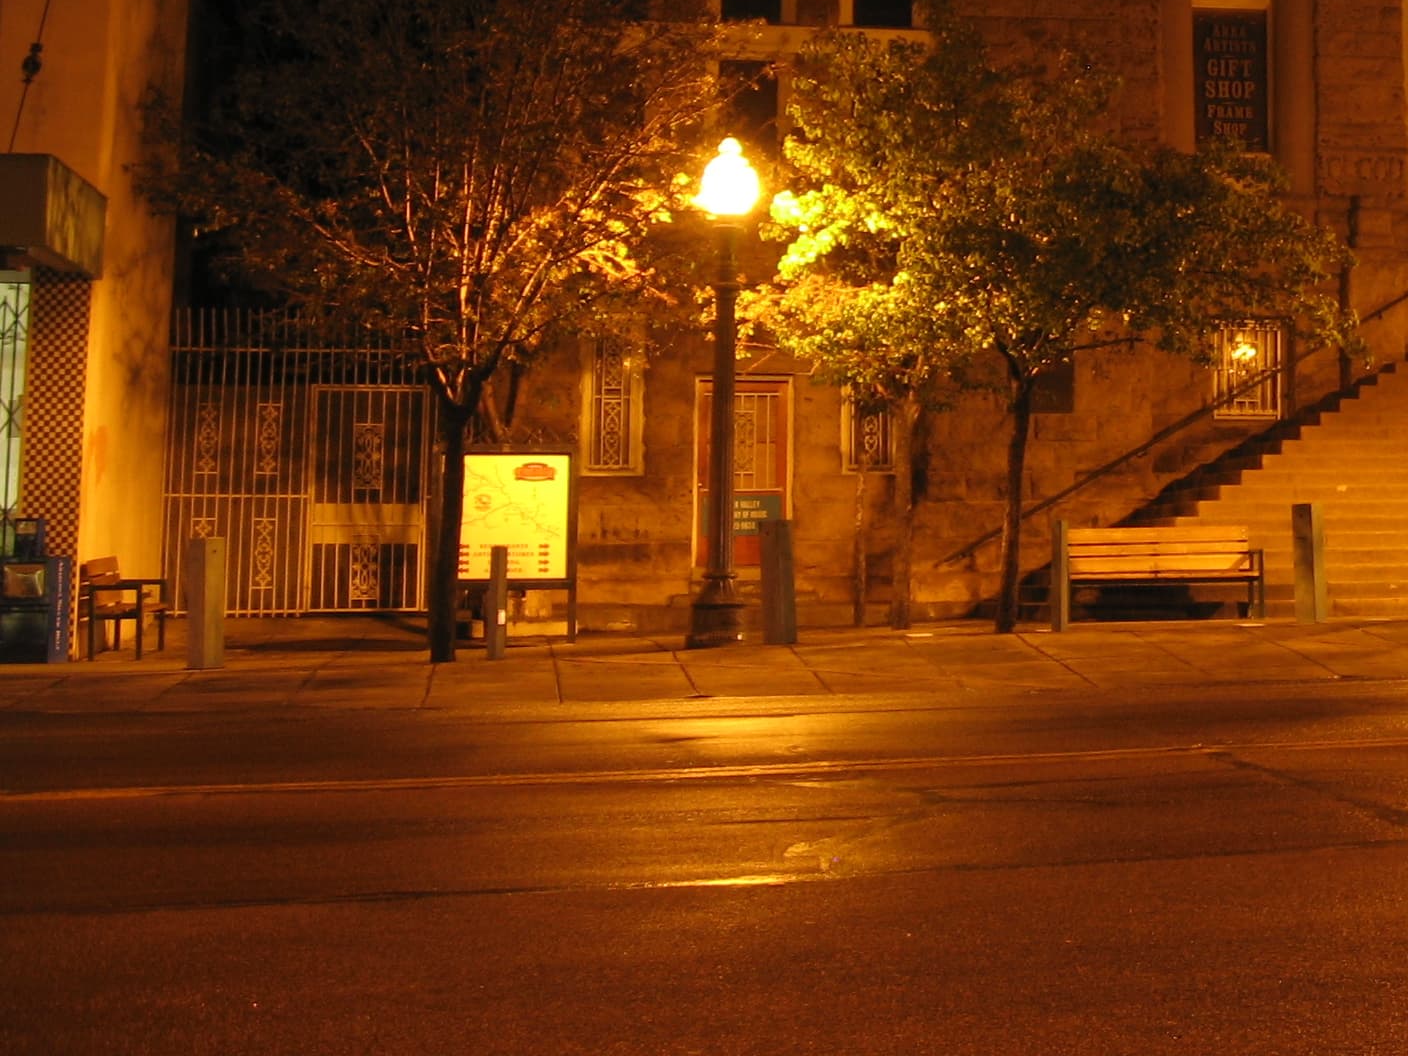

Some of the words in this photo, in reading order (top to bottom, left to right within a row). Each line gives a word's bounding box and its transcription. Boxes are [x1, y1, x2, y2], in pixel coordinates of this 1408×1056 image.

[1207, 58, 1254, 77] GIFT
[1205, 80, 1256, 99] SHOP
[1207, 104, 1254, 119] FRAME
[1213, 120, 1248, 137] SHOP
